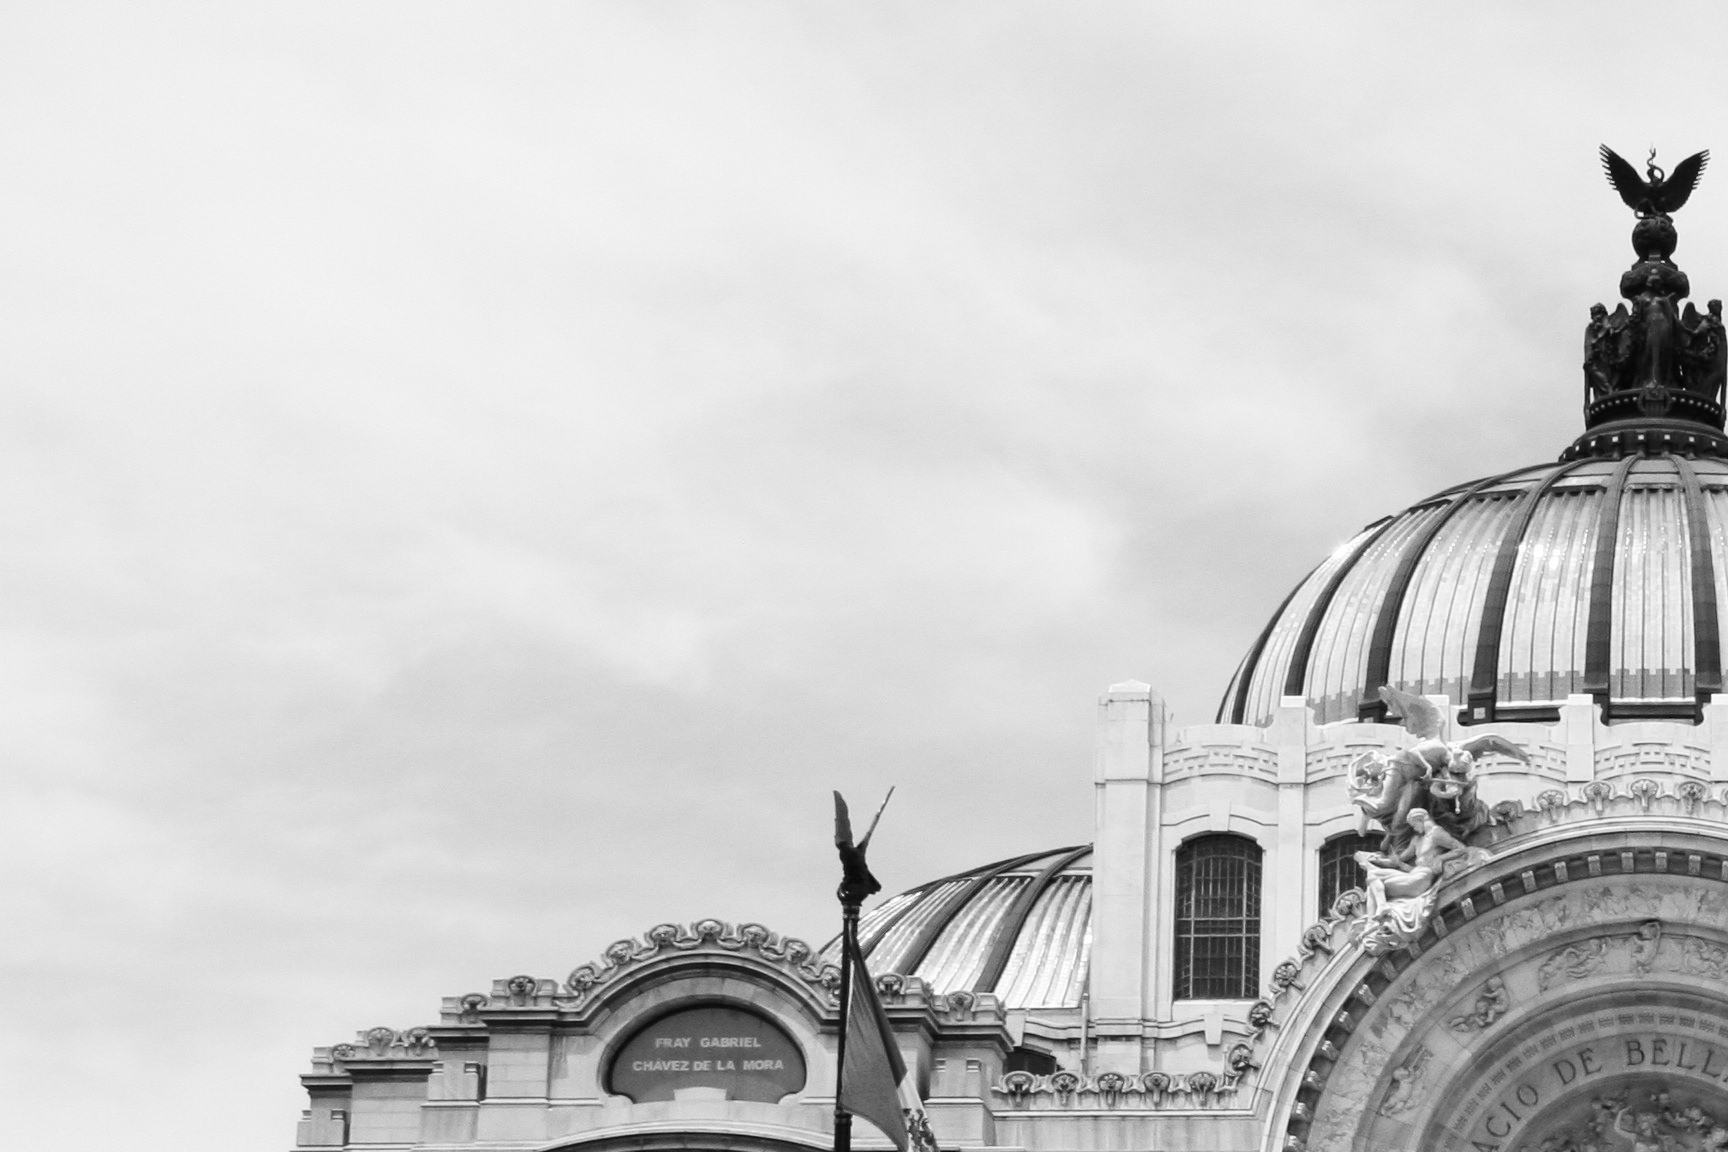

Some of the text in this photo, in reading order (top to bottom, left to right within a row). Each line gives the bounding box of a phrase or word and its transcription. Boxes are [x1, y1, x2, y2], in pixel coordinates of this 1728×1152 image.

[655, 1037, 761, 1048] FRAY GABRIEL
[692, 1060, 711, 1071] DE
[717, 1060, 735, 1071] LA
[743, 1060, 784, 1071] MORA
[1552, 1048, 1603, 1087] DE
